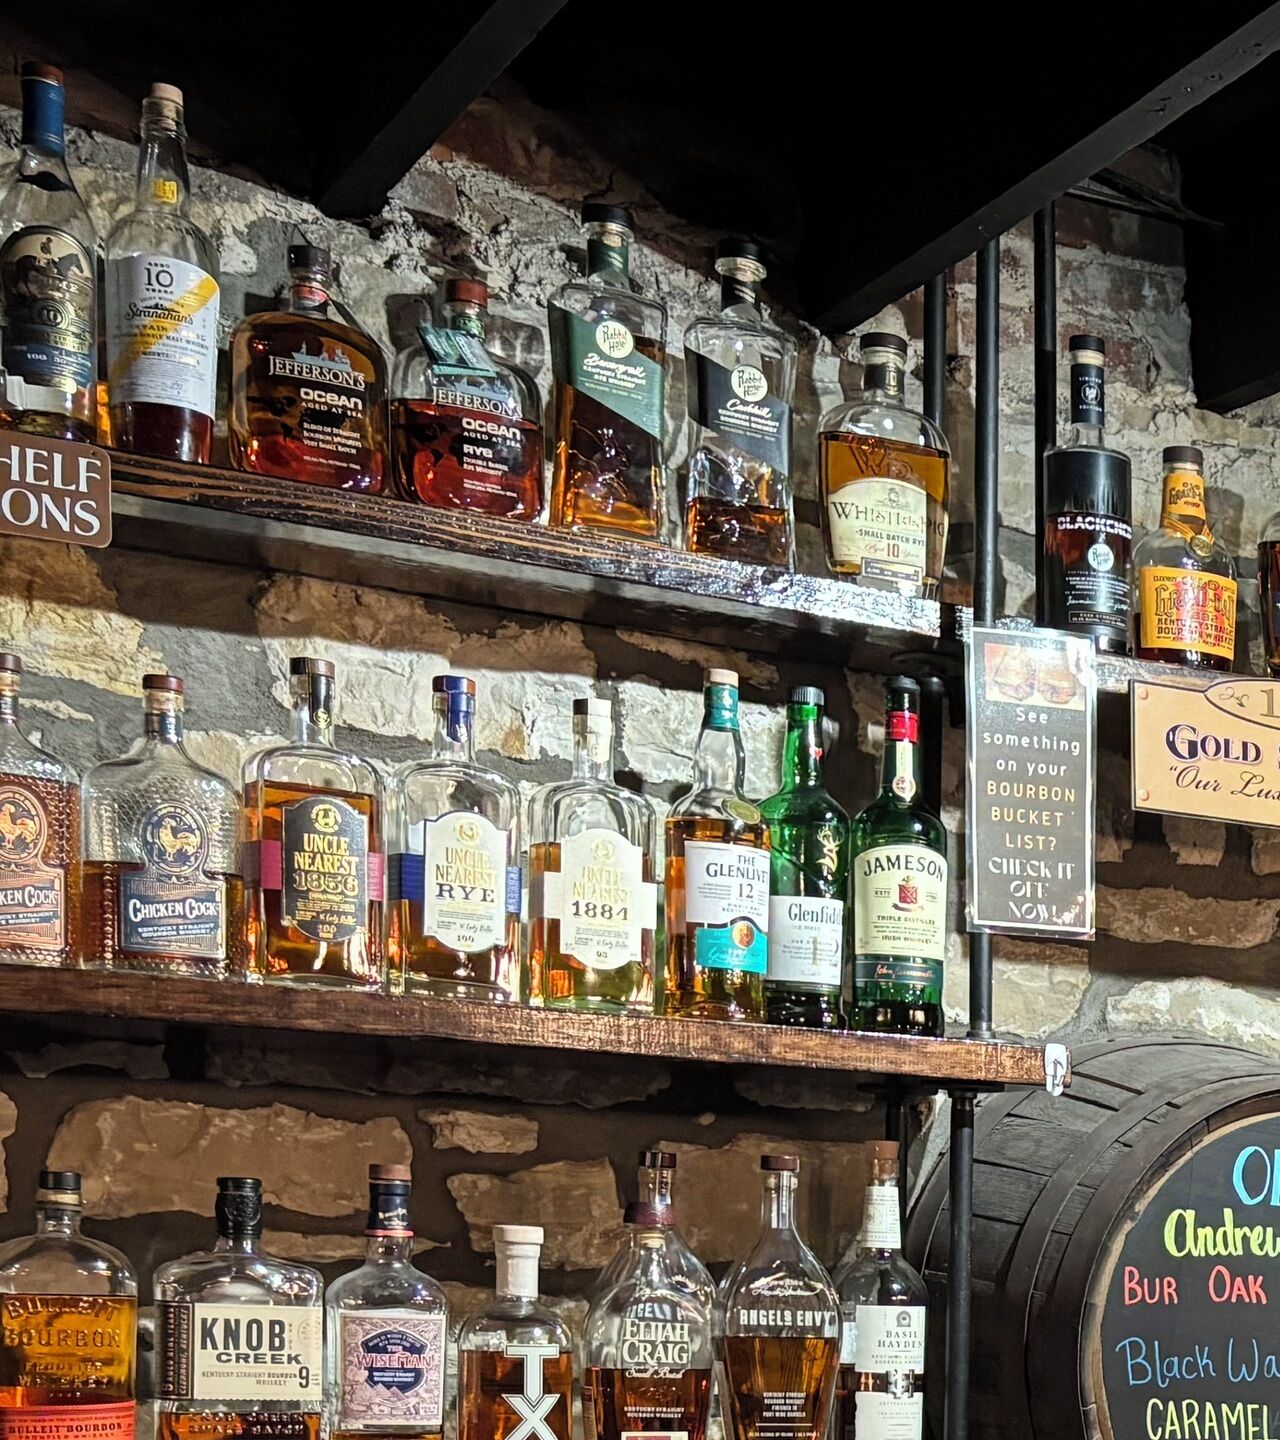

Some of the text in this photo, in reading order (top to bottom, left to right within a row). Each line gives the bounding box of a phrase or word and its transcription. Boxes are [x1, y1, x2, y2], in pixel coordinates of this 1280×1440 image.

[144, 267, 173, 287] 10
[124, 302, 195, 325] Stranahan's
[269, 355, 365, 390] JEFFERSON'S
[300, 387, 363, 411] OCEAN
[432, 386, 523, 420] JEFFERSON'S
[462, 417, 520, 439] OCEAN
[463, 444, 493, 458] RYE
[859, 528, 910, 545] SMALL BATCH
[1016, 707, 1048, 724] See
[983, 731, 1081, 756] something
[1165, 723, 1262, 763] GOLD
[996, 757, 1068, 777] on your
[987, 781, 1076, 803] BOURBON
[991, 806, 1064, 827] BUCKET
[303, 832, 349, 856] UNCLE
[1005, 831, 1057, 851] LIST?
[293, 852, 359, 876] NEAREST
[863, 855, 944, 883] JAMESON
[988, 856, 1075, 880] CHECK IT
[435, 883, 495, 903] RYE
[738, 883, 754, 899] 12
[1009, 880, 1048, 899] OFF
[128, 897, 220, 923] CHICKEN COCK
[572, 900, 629, 921] 1884
[1123, 1266, 1179, 1305] BUR
[1208, 1265, 1268, 1304] OAK
[796, 1310, 831, 1327] ENVY
[201, 1317, 286, 1352] KNOB
[624, 1319, 689, 1342] ELIJAH
[215, 1353, 303, 1365] CREEK
[356, 1352, 433, 1369] WISEMAN
[622, 1338, 689, 1365] CRAIG
[1115, 1336, 1216, 1388] Black
[298, 1366, 311, 1389] 9
[8, 1422, 123, 1434] BULLEIT BOURBON
